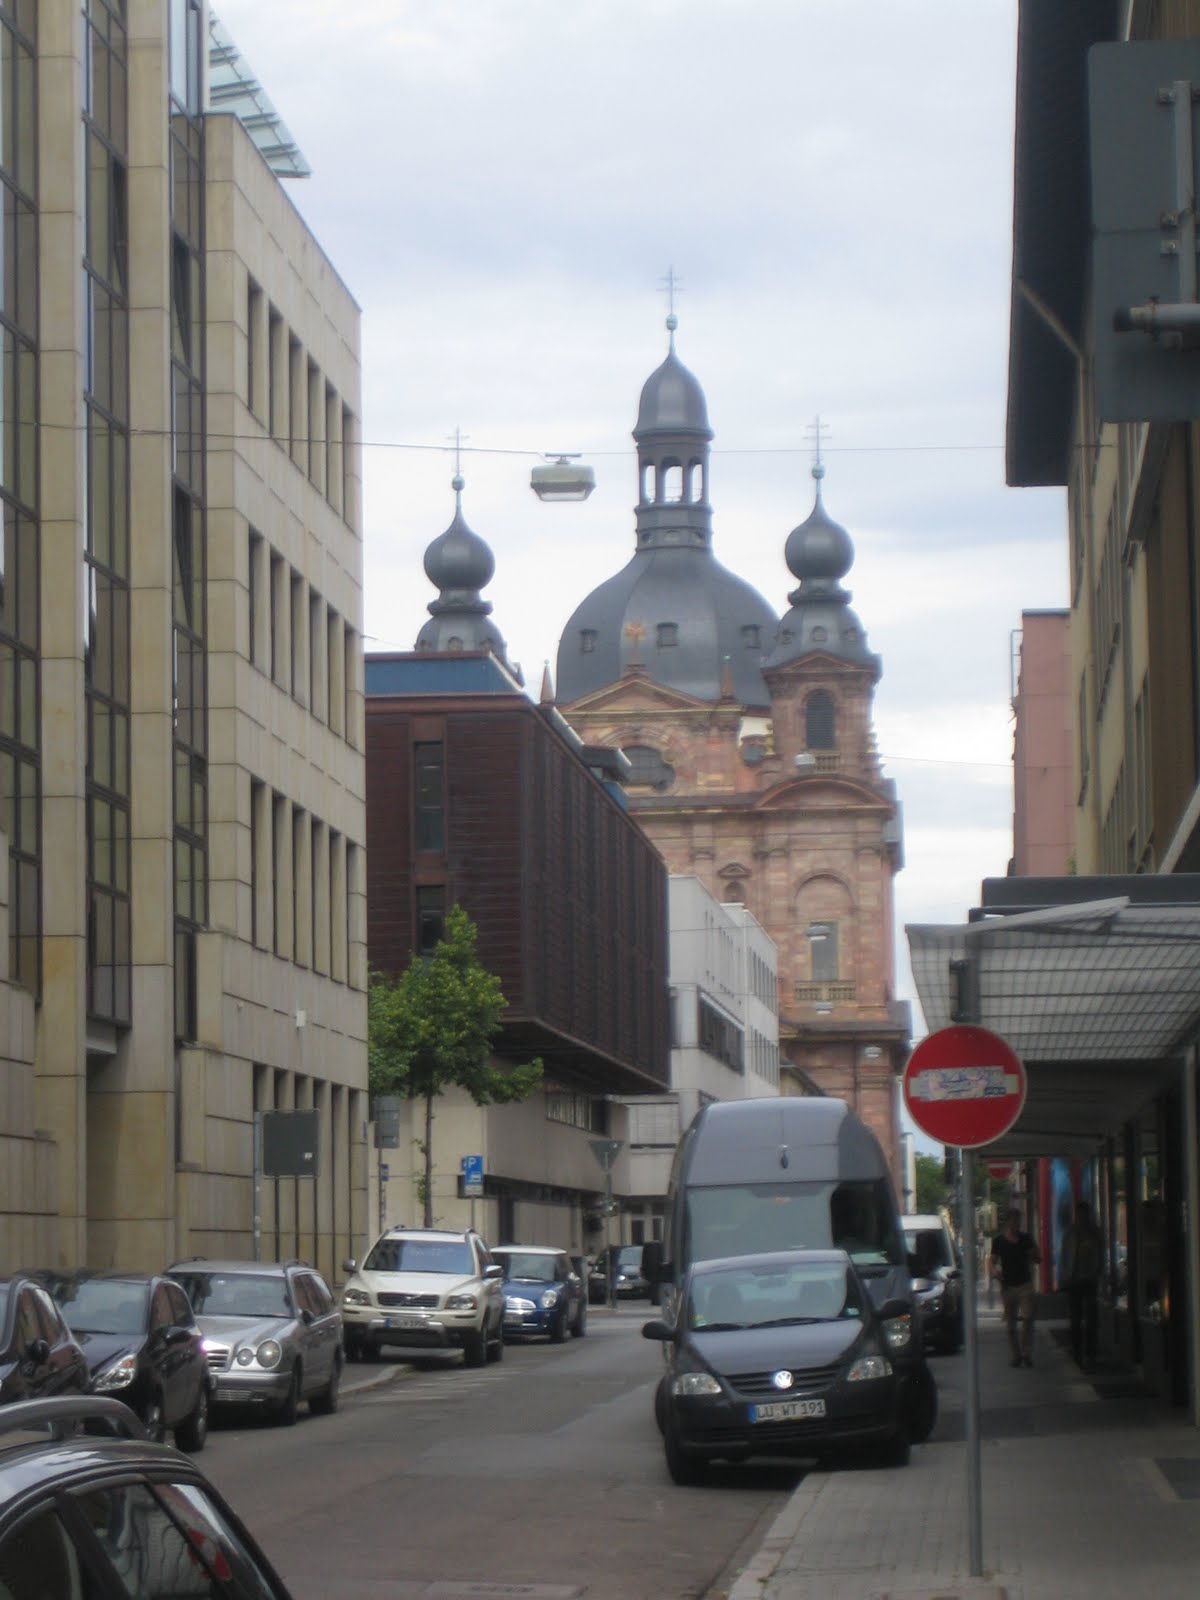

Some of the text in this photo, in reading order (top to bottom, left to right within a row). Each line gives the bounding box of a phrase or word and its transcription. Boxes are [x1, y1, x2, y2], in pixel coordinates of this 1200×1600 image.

[758, 1401, 825, 1418] LU WT 191
